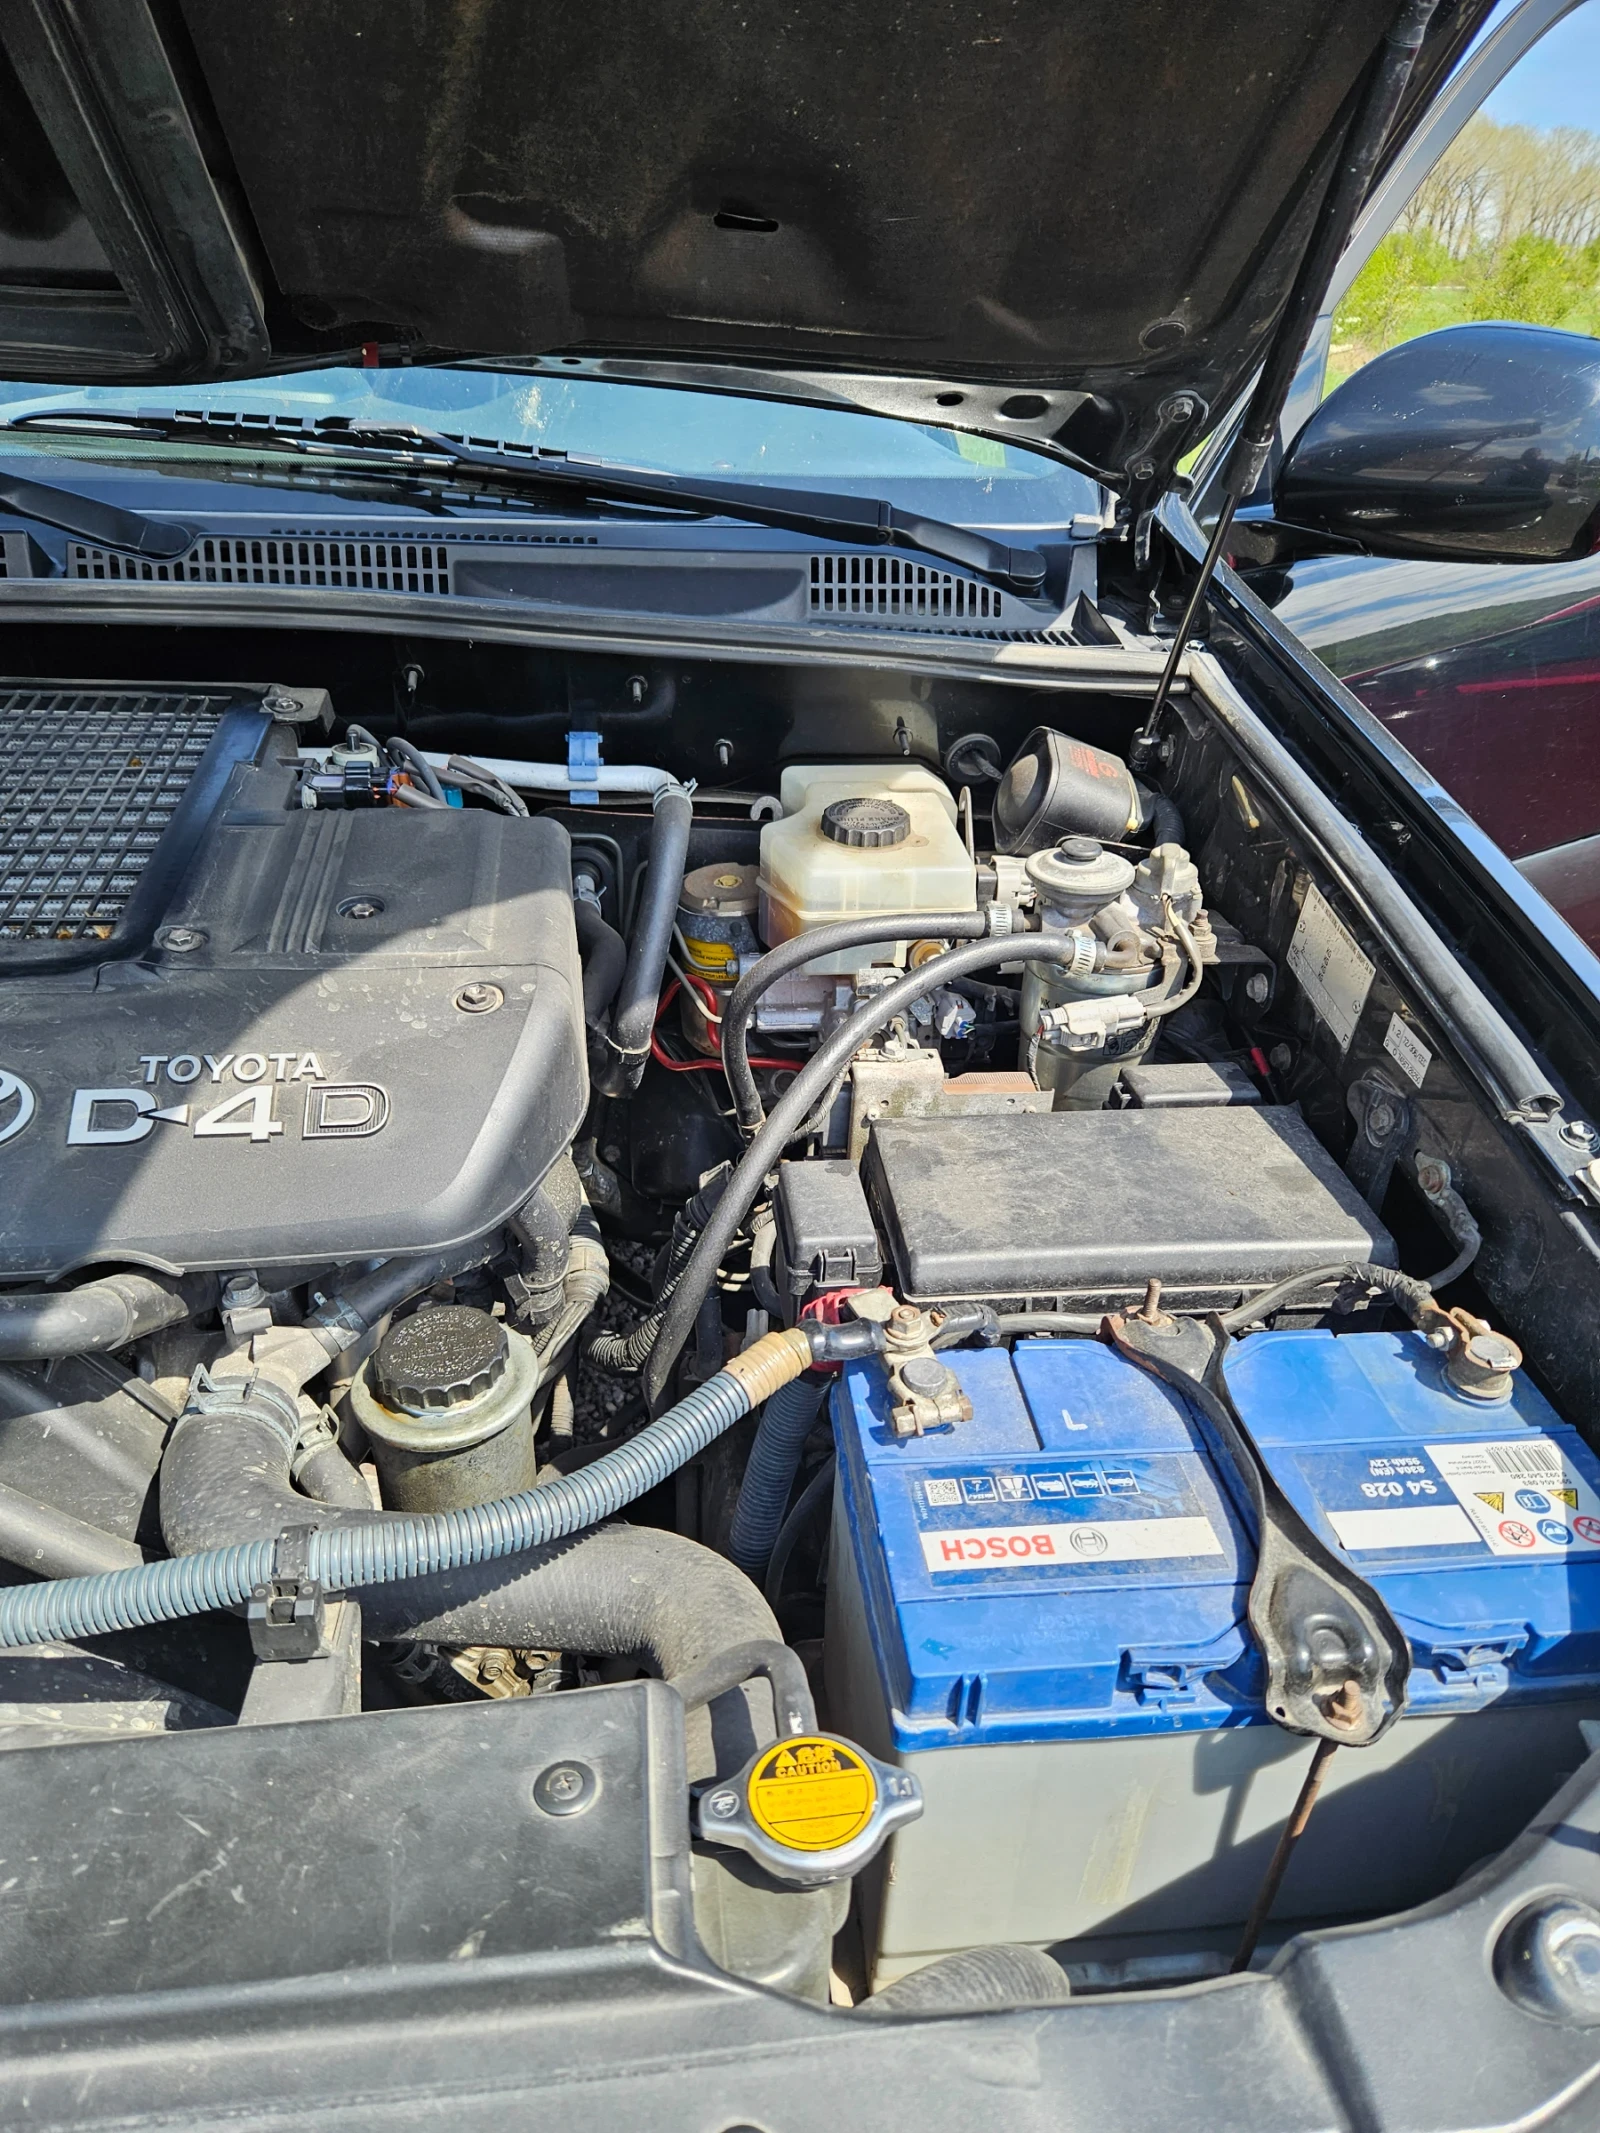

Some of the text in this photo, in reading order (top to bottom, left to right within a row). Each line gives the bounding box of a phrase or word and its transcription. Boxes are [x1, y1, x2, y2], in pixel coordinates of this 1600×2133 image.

[140, 1052, 326, 1084] TOYOTA
[1369, 1457, 1421, 1468] 95Ah 12V
[1369, 1465, 1426, 1477] 830A (EN)
[1361, 1480, 1438, 1498] S4 028
[940, 1535, 1055, 1561] BOSCH
[775, 1760, 842, 1778] CAUTION
